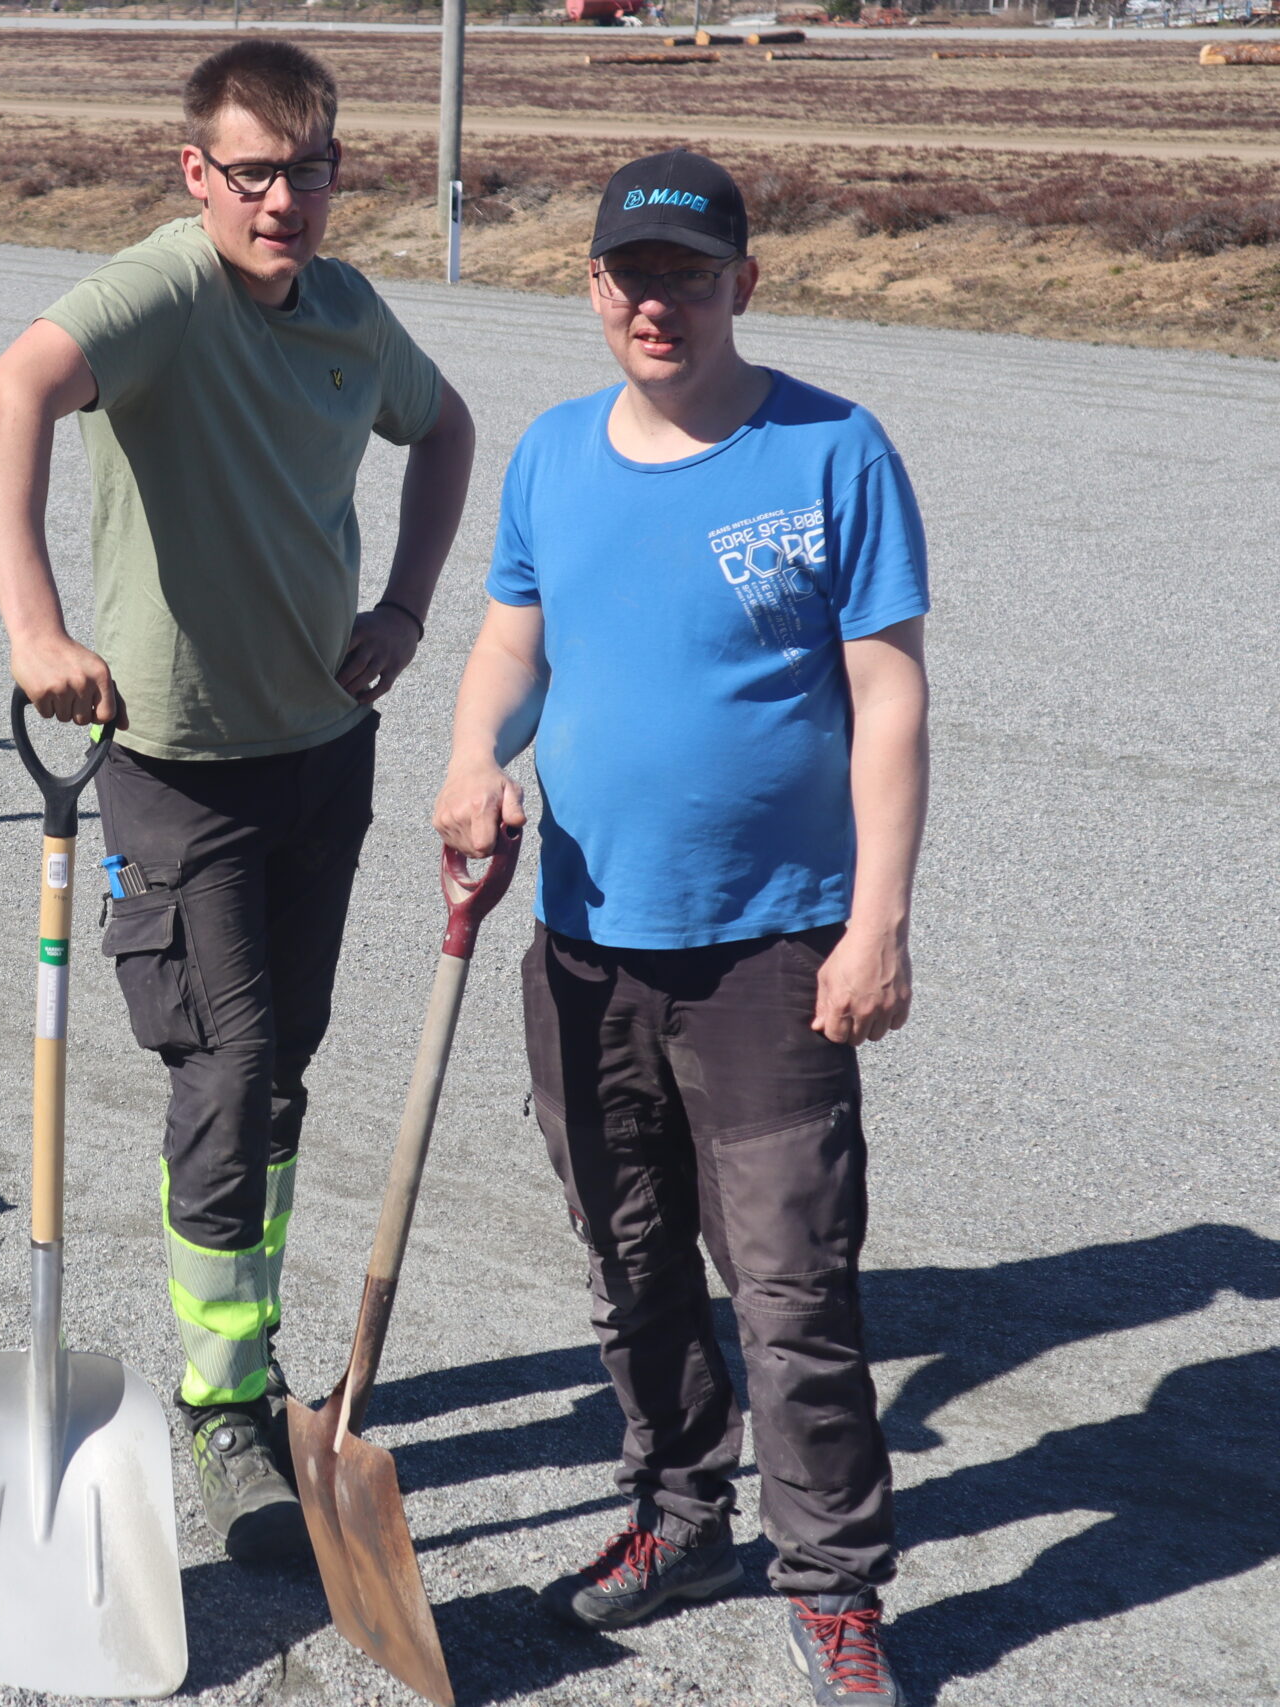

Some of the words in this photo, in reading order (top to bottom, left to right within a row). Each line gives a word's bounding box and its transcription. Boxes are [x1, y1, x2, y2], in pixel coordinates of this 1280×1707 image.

[648, 188, 709, 213] MAPEI
[707, 525, 732, 539] JEANS
[732, 509, 785, 529] INTELLIGENCE
[710, 527, 757, 554] CORE
[719, 527, 827, 585] CORE
[46, 969, 57, 1030] BILTEMA
